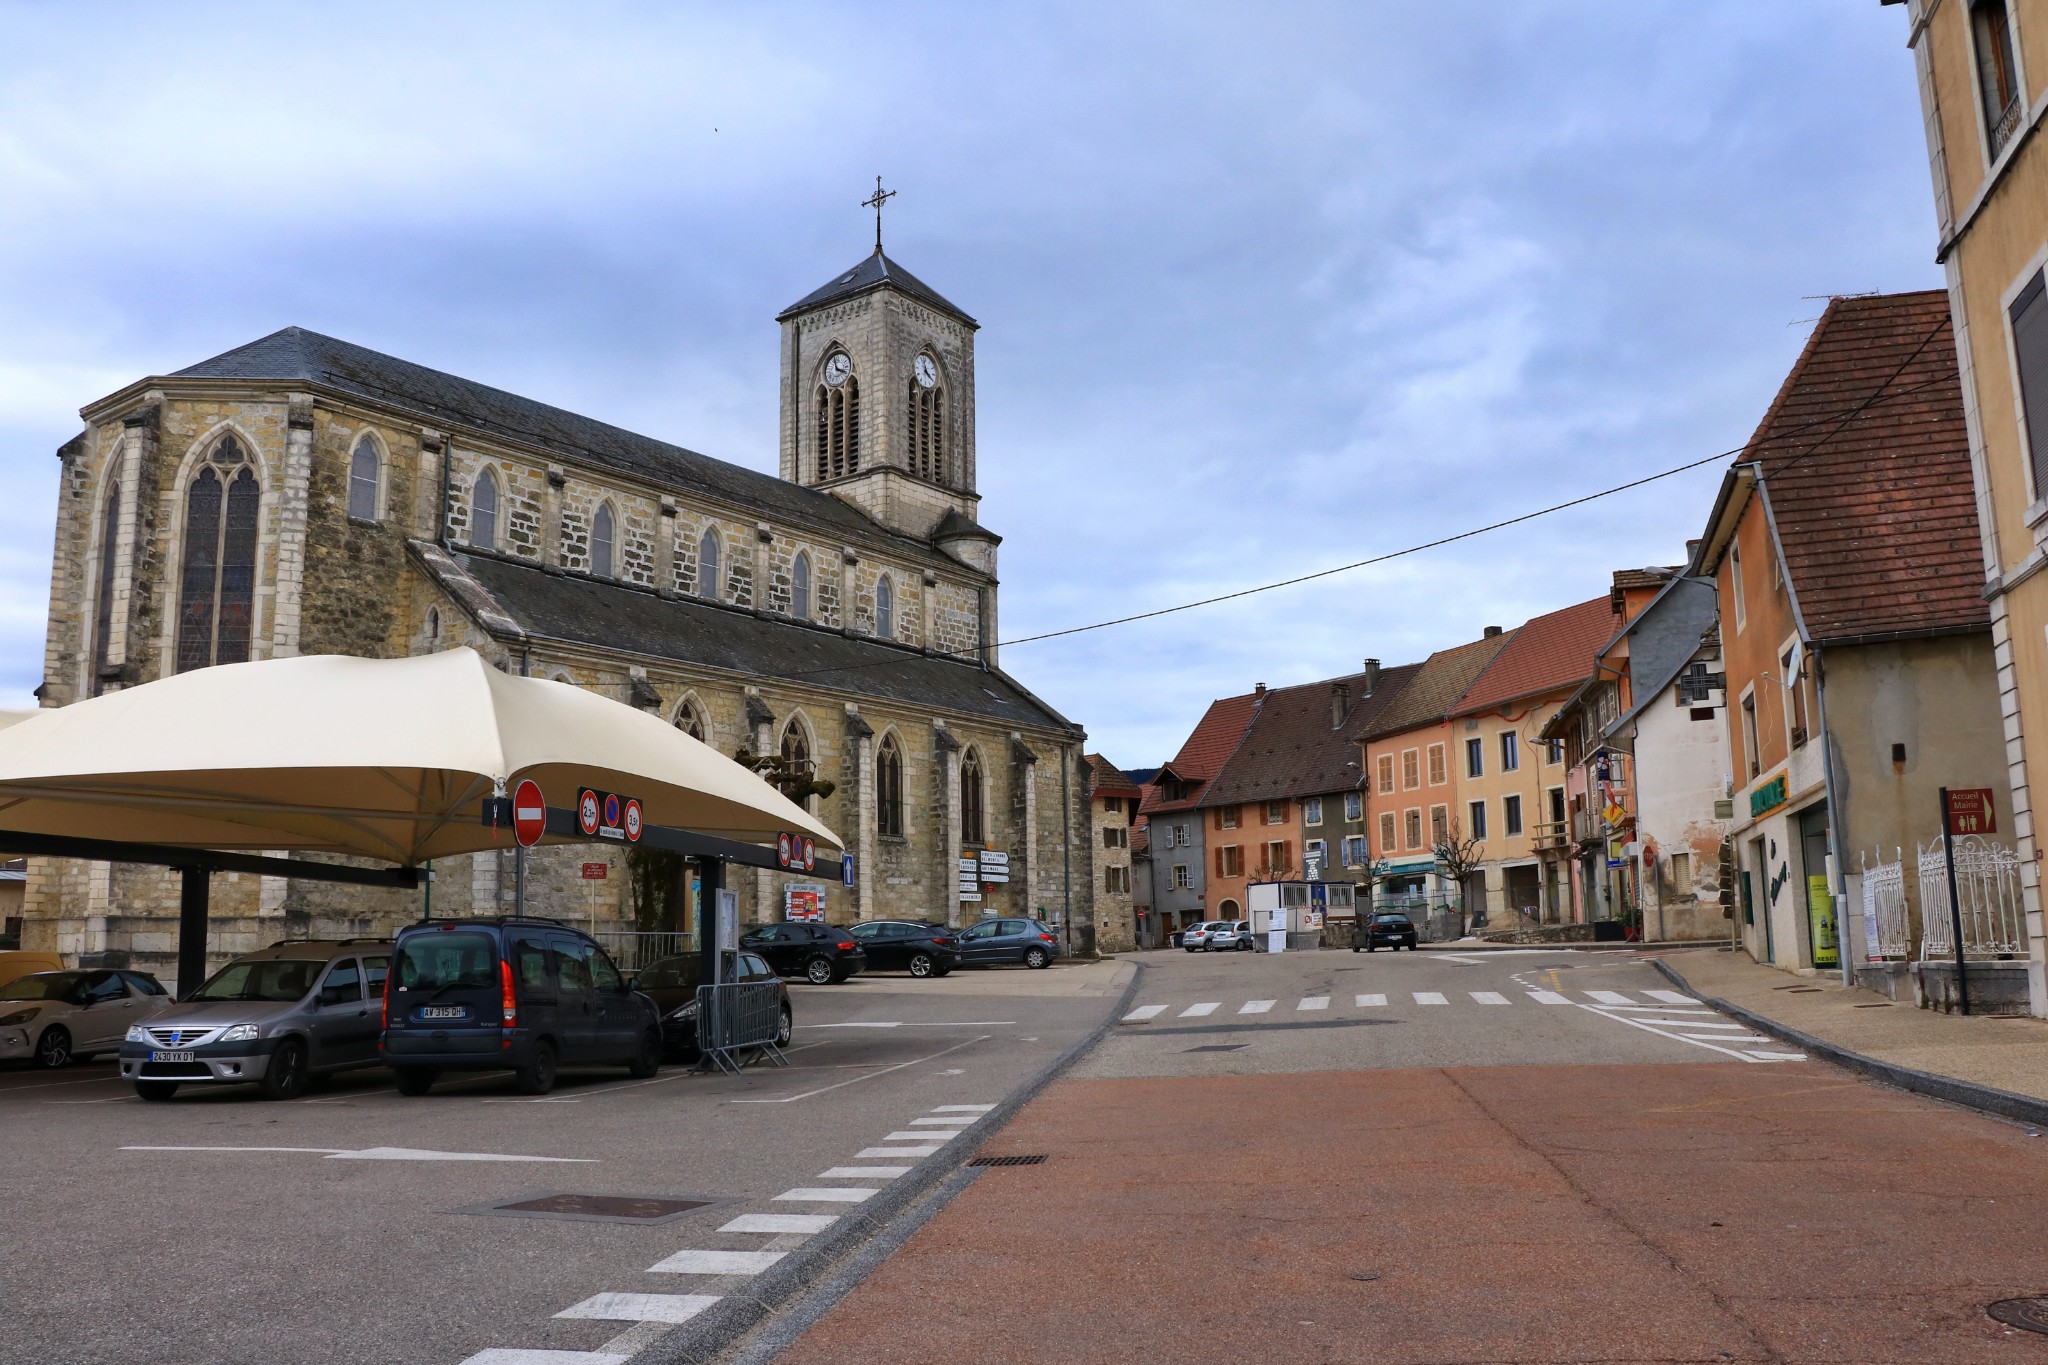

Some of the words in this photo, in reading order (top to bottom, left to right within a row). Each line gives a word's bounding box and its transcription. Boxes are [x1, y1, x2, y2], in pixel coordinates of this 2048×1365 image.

[1952, 792, 1979, 800] Accueil
[1954, 801, 1978, 809] Mairie
[153, 1052, 171, 1062] 2430
[172, 1052, 182, 1062] YX
[184, 1052, 193, 1062] 01
